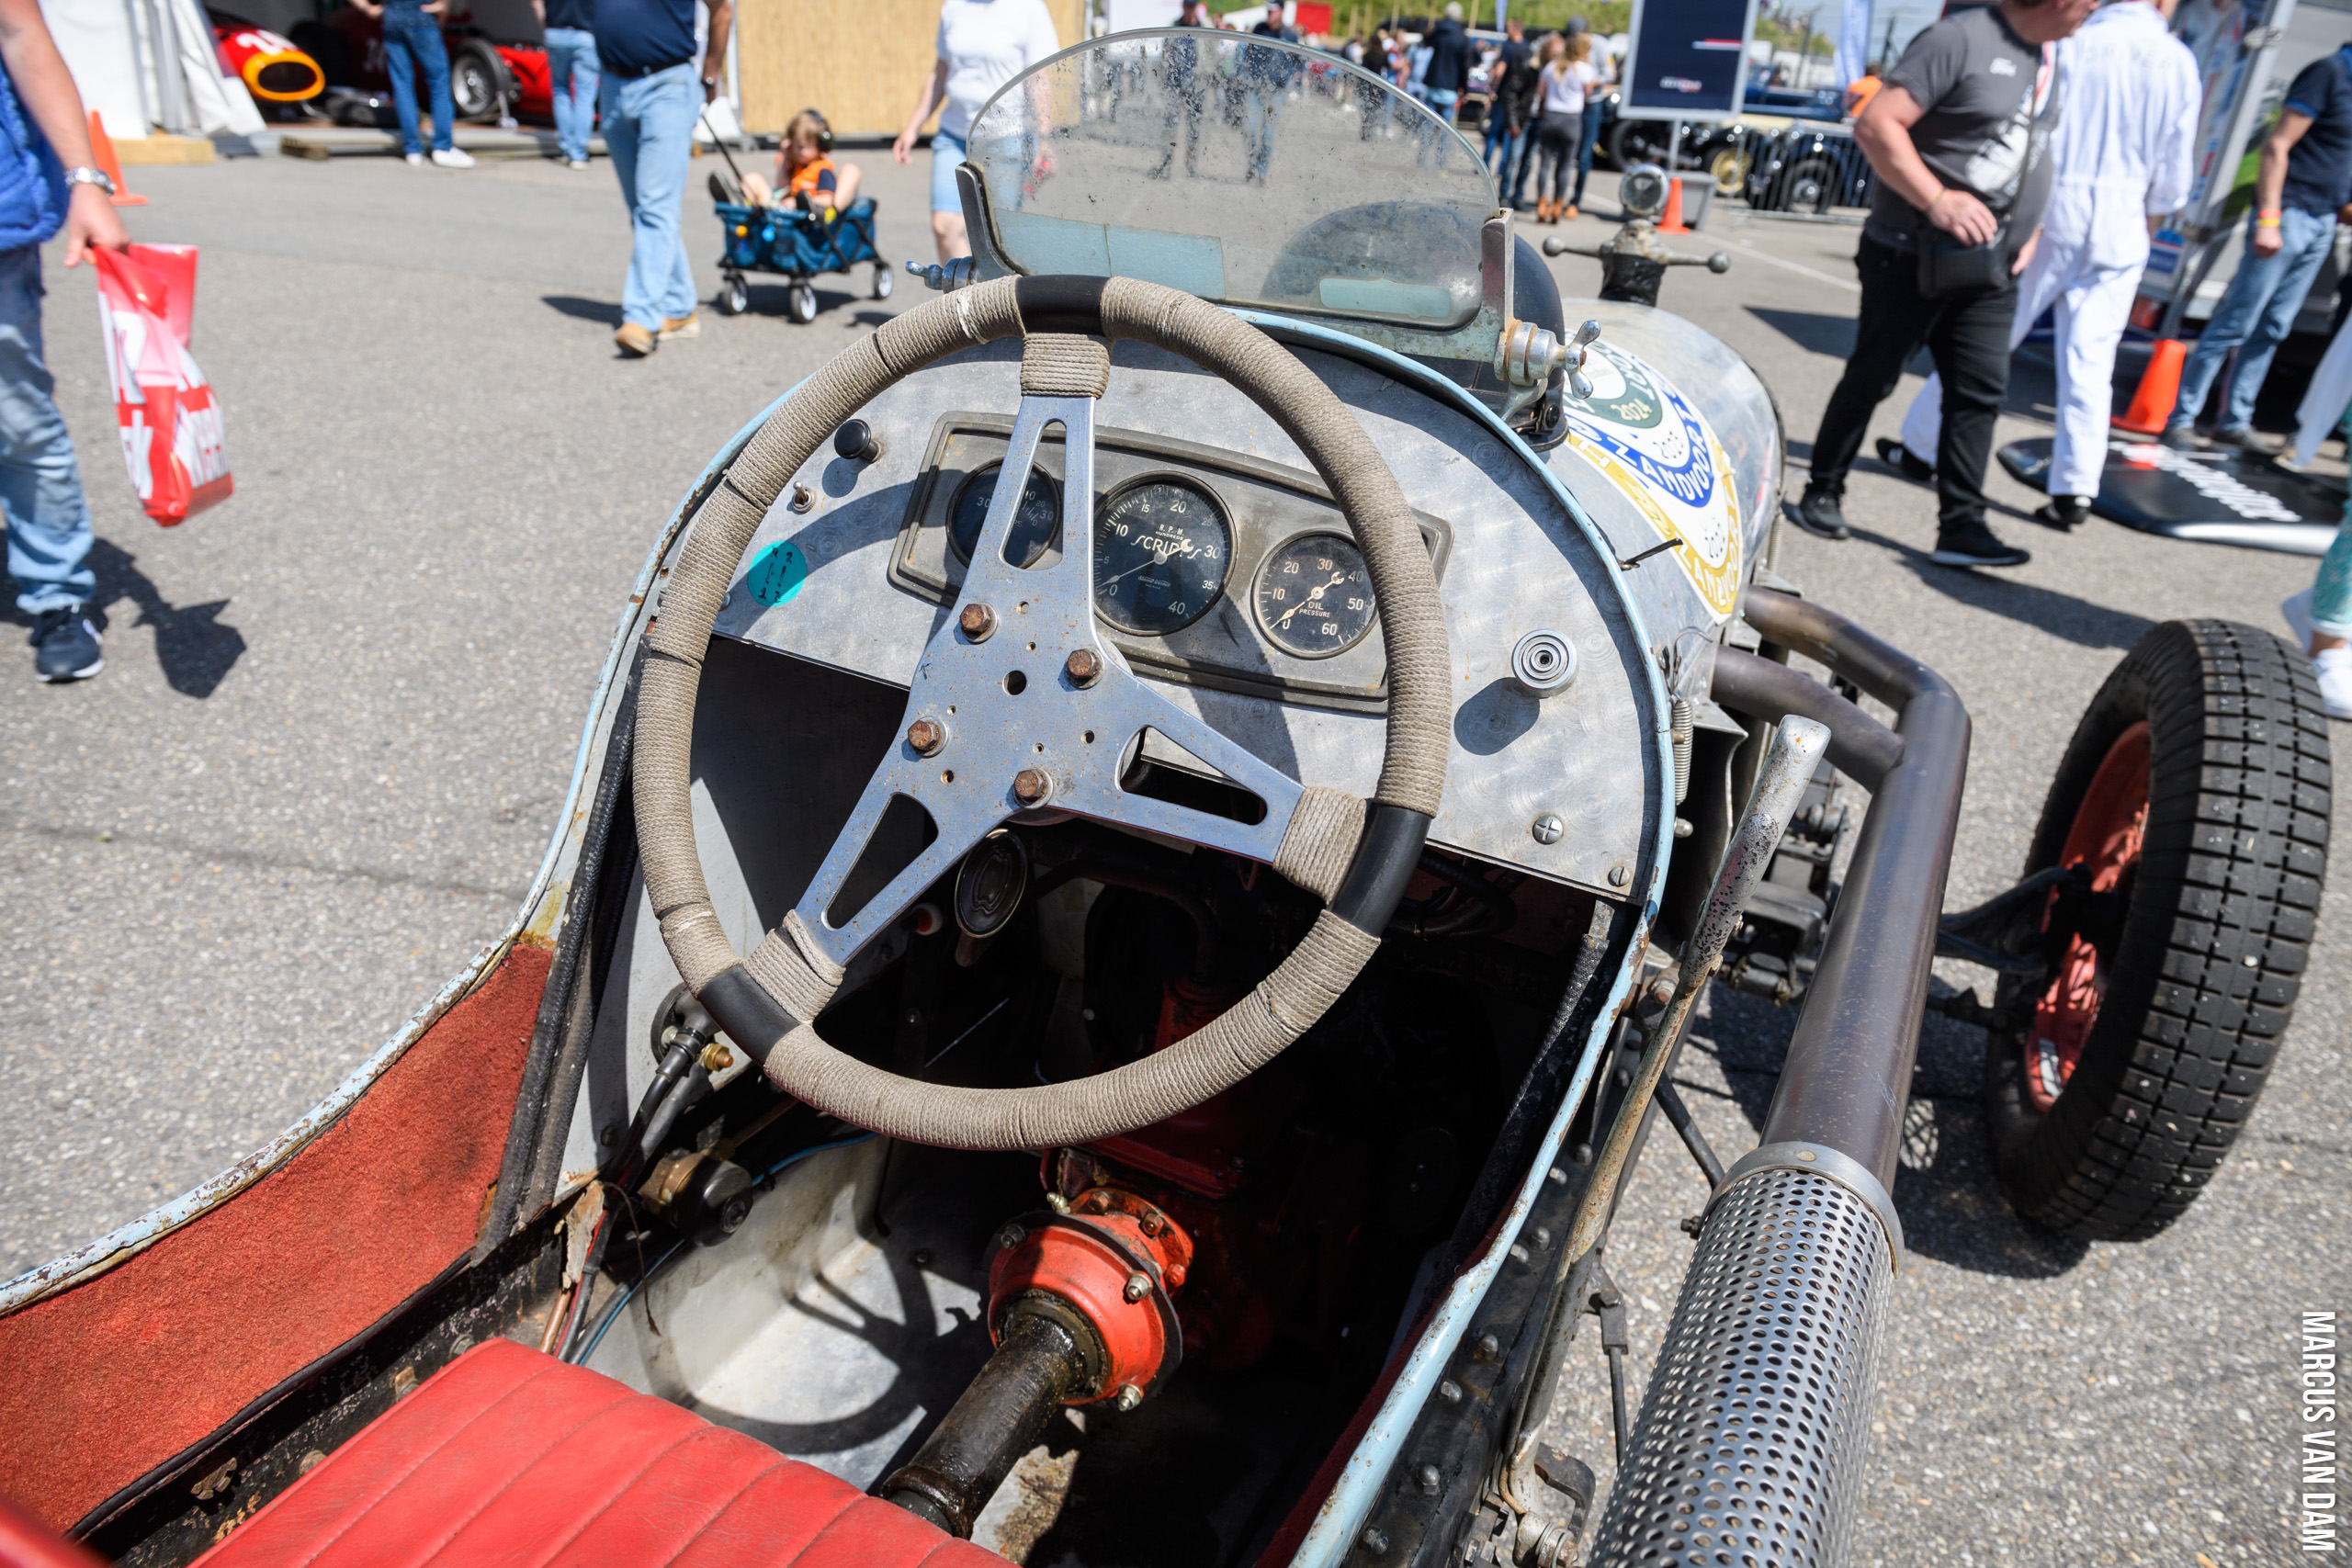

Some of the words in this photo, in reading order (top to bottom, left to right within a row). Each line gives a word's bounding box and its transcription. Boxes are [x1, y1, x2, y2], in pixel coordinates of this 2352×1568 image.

[1610, 398, 1653, 422] 2024
[1141, 504, 1150, 513] 15
[1170, 500, 1187, 513] 20
[1039, 509, 1055, 521] 30
[1201, 517, 1213, 527] 25
[1115, 523, 1129, 537] 10
[1155, 531, 1183, 541] HUNDREDS
[1130, 535, 1203, 559] SCRIPS
[1204, 545, 1222, 559] 30
[1103, 556, 1110, 564] 5
[1317, 558, 1333, 570] 30
[1283, 561, 1299, 574] 20
[1348, 570, 1363, 582] 40
[1109, 583, 1118, 596] 0
[1202, 580, 1214, 590] 35
[1272, 588, 1285, 600] 10
[1168, 601, 1185, 615] 40
[1307, 601, 1324, 611] OIL
[1347, 597, 1363, 611] 50
[1298, 608, 1331, 618] PRESSURE
[1321, 622, 1338, 636] 60
